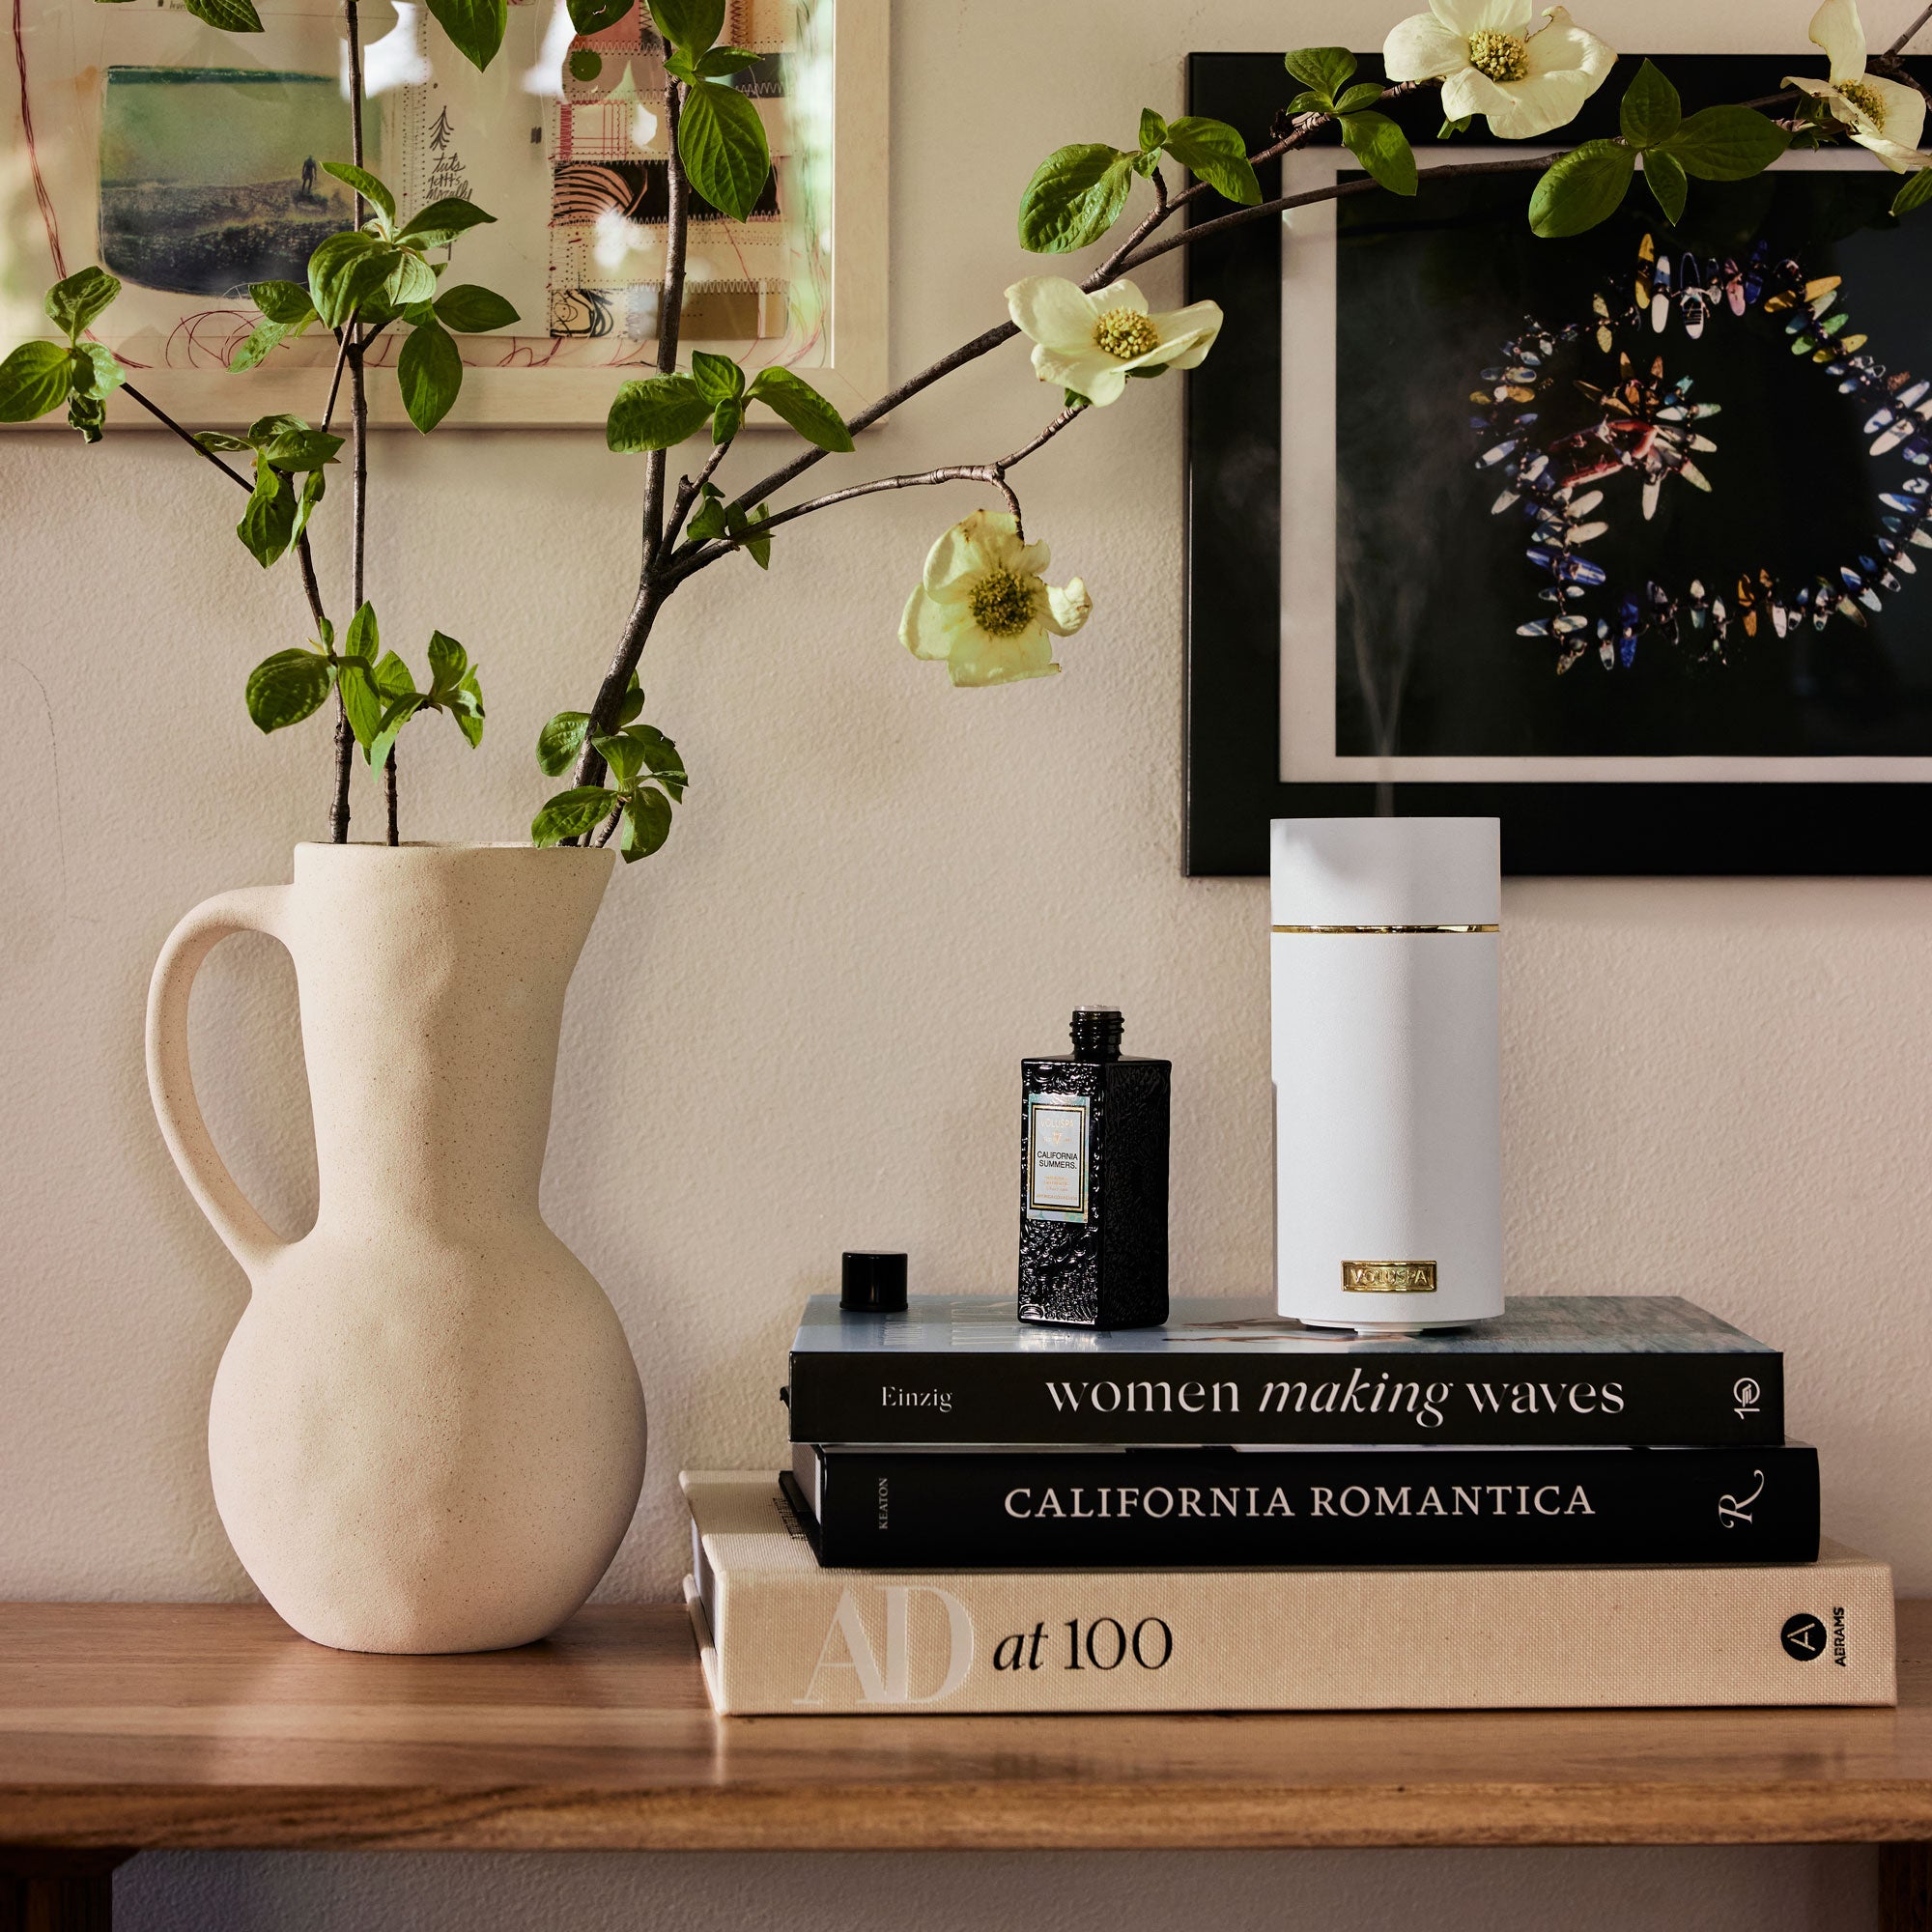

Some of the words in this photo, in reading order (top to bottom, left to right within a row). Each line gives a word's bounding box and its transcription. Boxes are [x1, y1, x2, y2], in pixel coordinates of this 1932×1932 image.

[1037, 1151, 1079, 1161] CALIFORNIA
[1350, 1266, 1429, 1287] VOLUSPA
[881, 1385, 953, 1413] Einzig
[1044, 1380, 1241, 1413] women
[1257, 1366, 1455, 1428] making
[1464, 1381, 1626, 1414] waves
[877, 1477, 889, 1530] KEATON
[1003, 1486, 1296, 1519] CALIFORNIA
[1310, 1484, 1597, 1518] ROMANTICA
[1717, 1469, 1766, 1528] R
[791, 1584, 975, 1706] AD
[992, 1621, 1049, 1671] at
[1063, 1616, 1174, 1671] 100
[1833, 1606, 1847, 1667] ABRAMS
